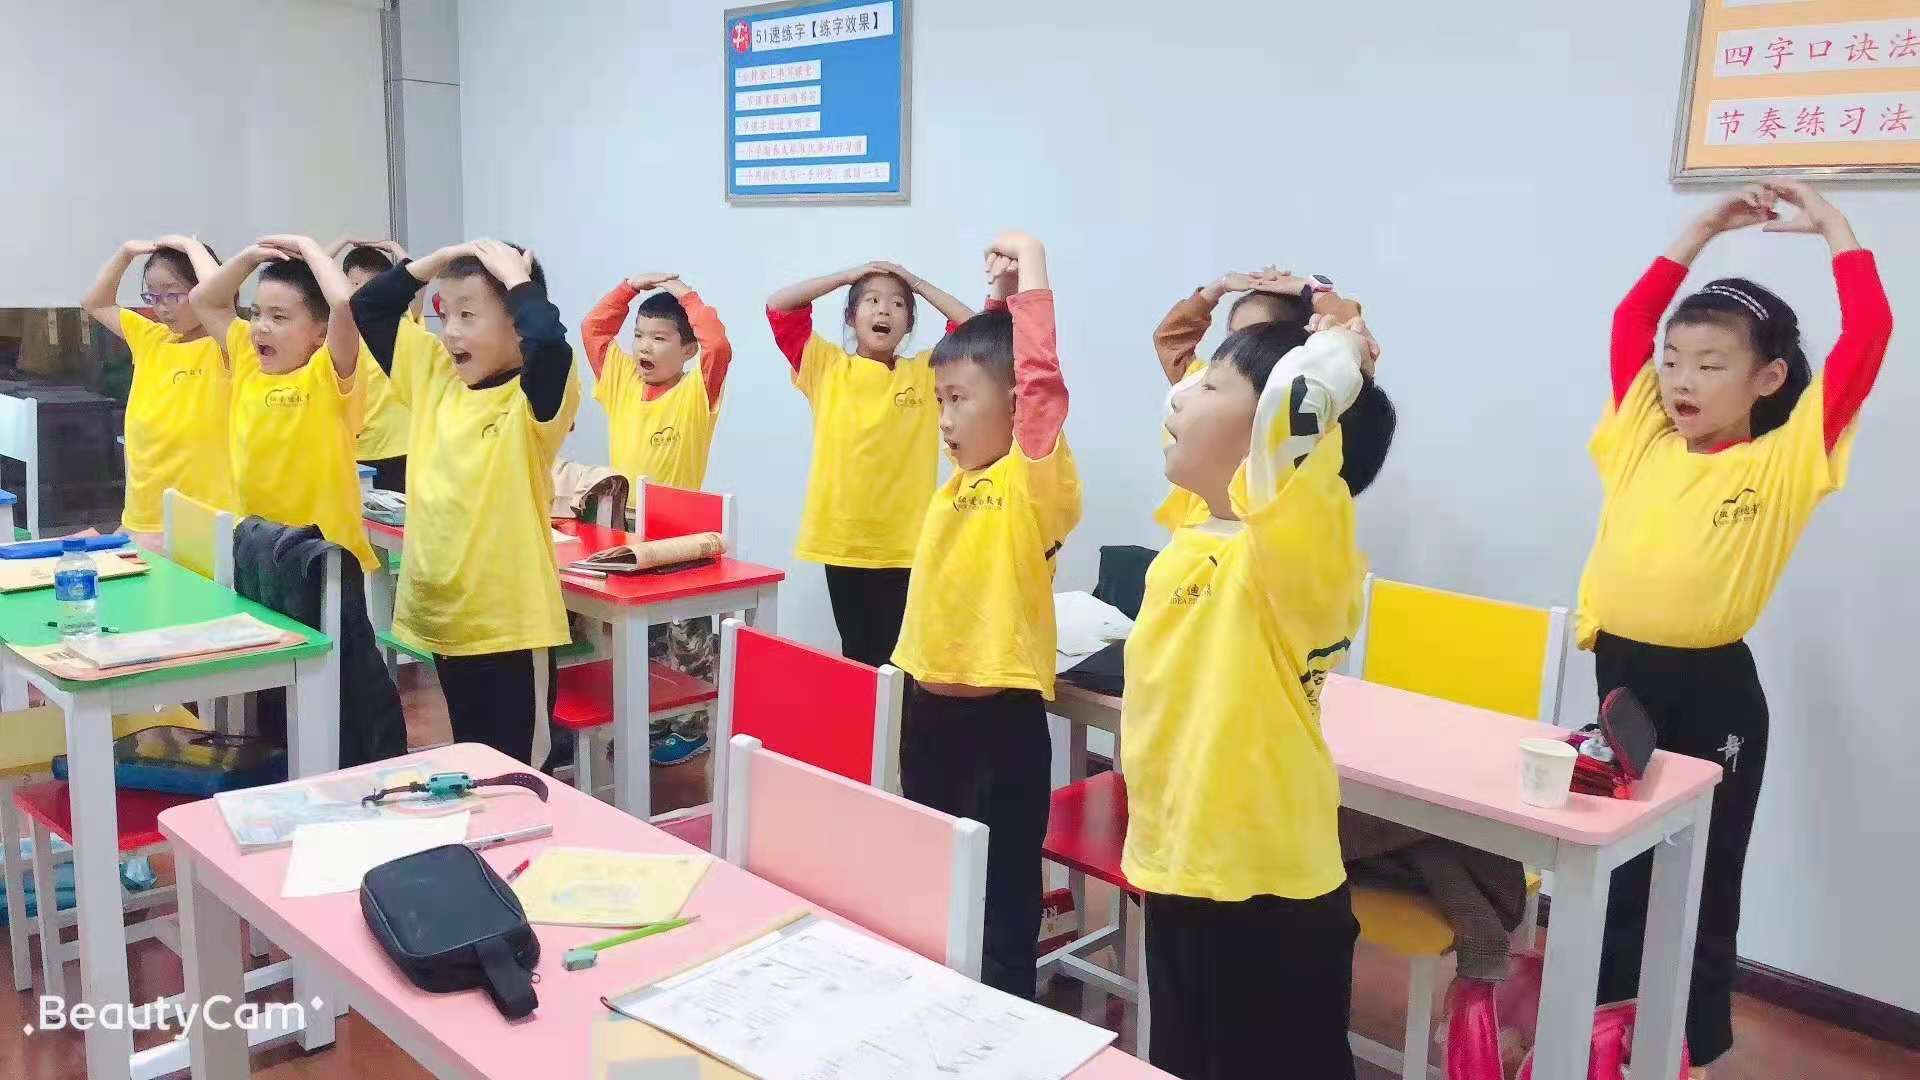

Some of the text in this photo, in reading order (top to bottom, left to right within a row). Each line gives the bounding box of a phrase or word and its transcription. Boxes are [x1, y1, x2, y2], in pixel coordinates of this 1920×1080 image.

[1724, 29, 1920, 69] 四字口诀法
[1716, 103, 1913, 142] 节奏练习法
